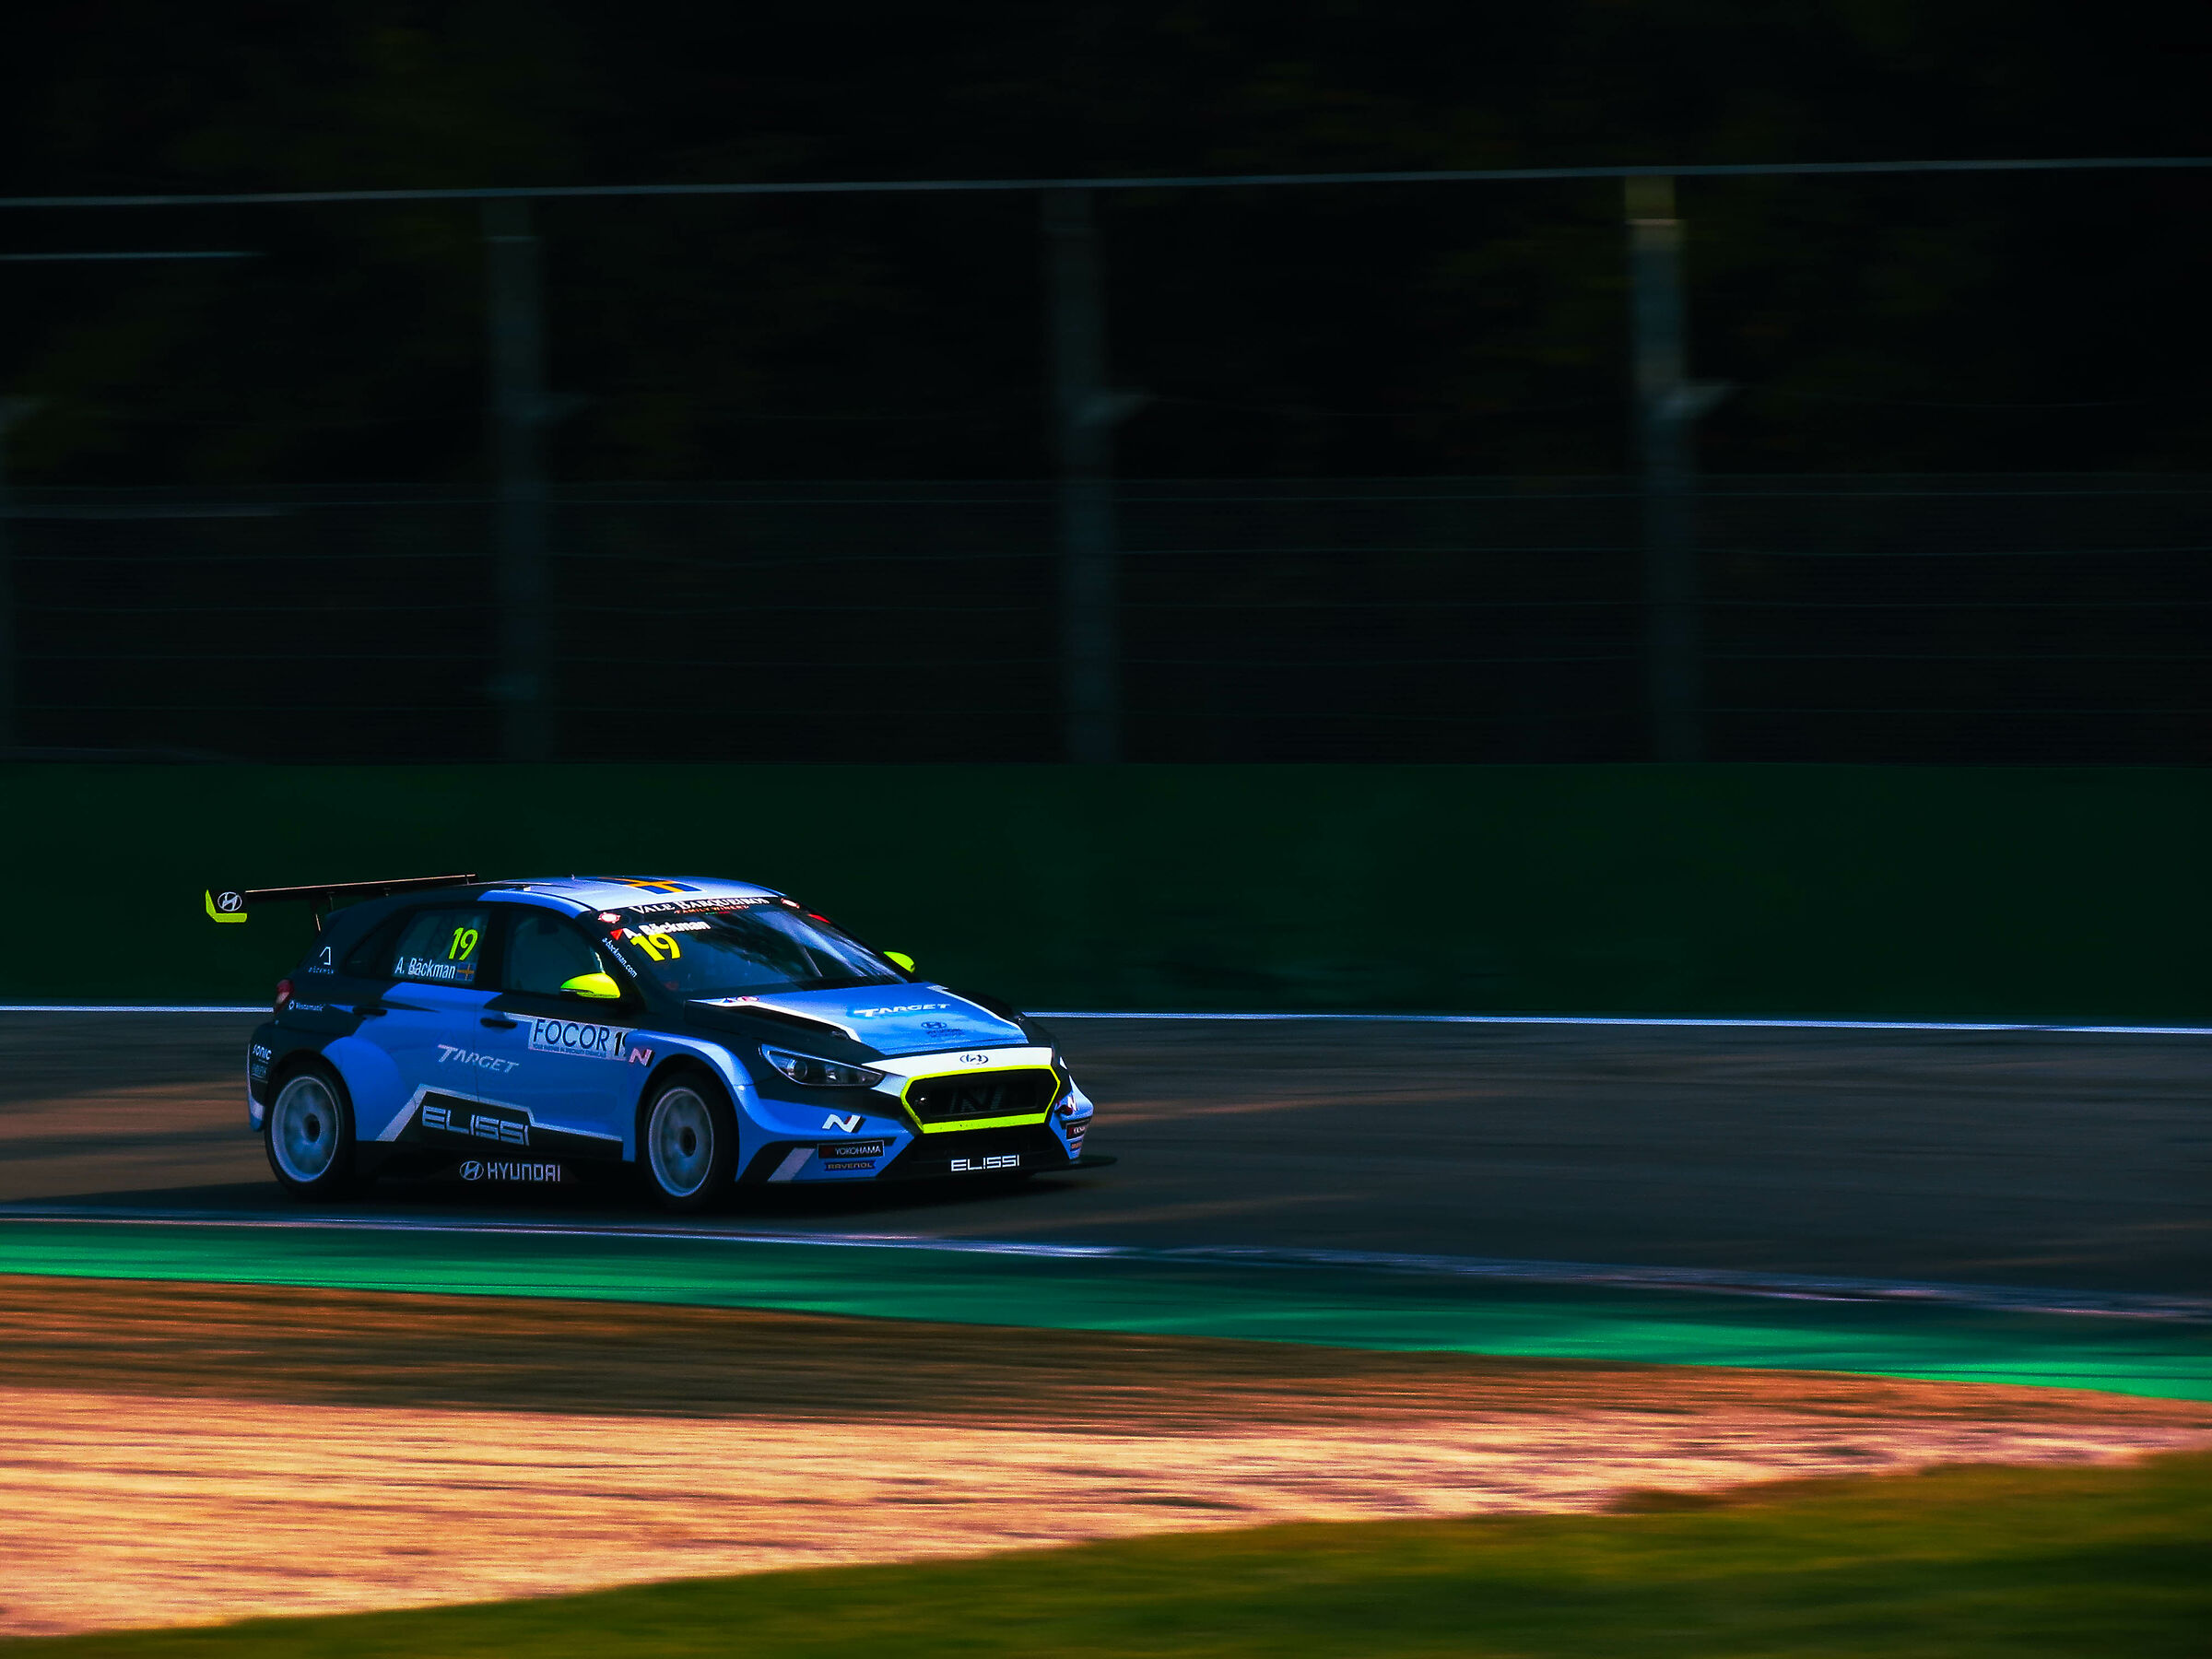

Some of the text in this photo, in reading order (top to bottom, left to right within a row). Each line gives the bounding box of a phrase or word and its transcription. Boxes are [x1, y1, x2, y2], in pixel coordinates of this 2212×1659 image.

[629, 904, 675, 914] VALE
[449, 927, 478, 960] 19
[630, 934, 681, 962] 19
[394, 957, 456, 979] A. Bäckman
[853, 1003, 951, 1018] TARGET
[534, 1018, 609, 1051] FOCOR
[437, 1043, 520, 1073] TARGET
[422, 1105, 530, 1147] ELISSI
[834, 1146, 882, 1156] YOKOHAMA
[487, 1161, 561, 1182] HYUNDAI
[951, 1154, 1020, 1172] ELISSI
